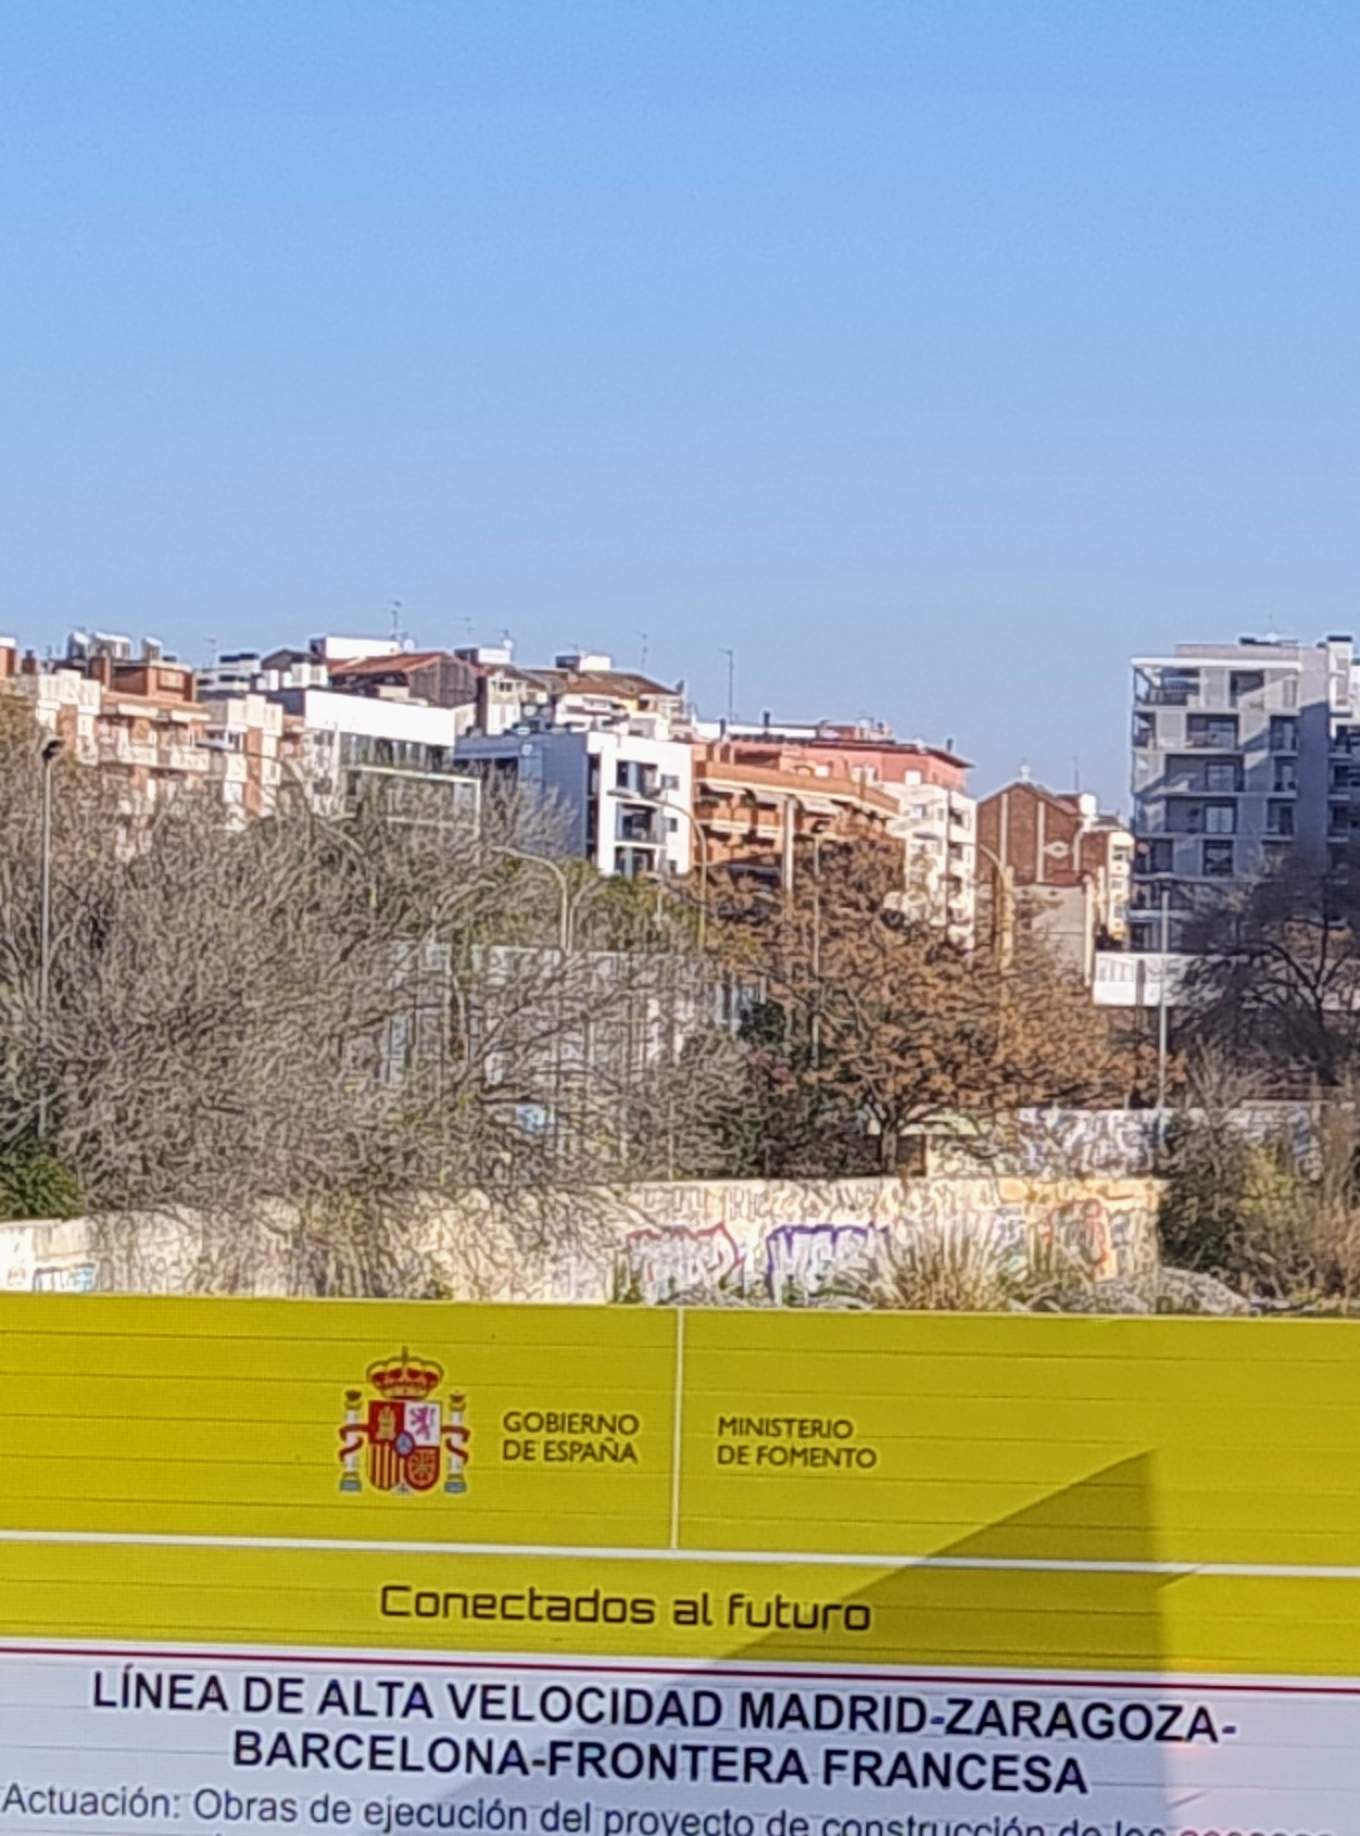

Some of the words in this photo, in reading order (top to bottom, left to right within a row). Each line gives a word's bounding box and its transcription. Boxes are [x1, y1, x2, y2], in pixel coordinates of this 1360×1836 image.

[503, 1410, 640, 1436] GOBIERNO
[717, 1416, 854, 1440] MINISTERIO
[503, 1439, 535, 1462] DE
[543, 1436, 639, 1464] ESPAÑA
[717, 1444, 748, 1467] DE
[756, 1445, 877, 1469] FOMENTO
[379, 1584, 655, 1625] Conectados
[673, 1590, 713, 1627] al
[726, 1593, 872, 1634] futuro
[93, 1663, 229, 1713] LÍNEA
[243, 1676, 306, 1715] DE
[317, 1679, 434, 1720] ALTA
[448, 1683, 723, 1730] VELOCIDAD
[739, 1690, 1237, 1743] MADRID-ZARAGOZA-
[232, 1729, 809, 1786] BARCELONA-FRONTERA
[823, 1748, 1089, 1796] FRANCESA
[1, 1782, 180, 1819] Actuación:
[193, 1787, 298, 1822] Obras
[309, 1794, 352, 1826] de
[363, 1796, 528, 1834] ejecución
[539, 1801, 591, 1833] del
[603, 1806, 755, 1836] proyecto
[766, 1809, 809, 1836] de
